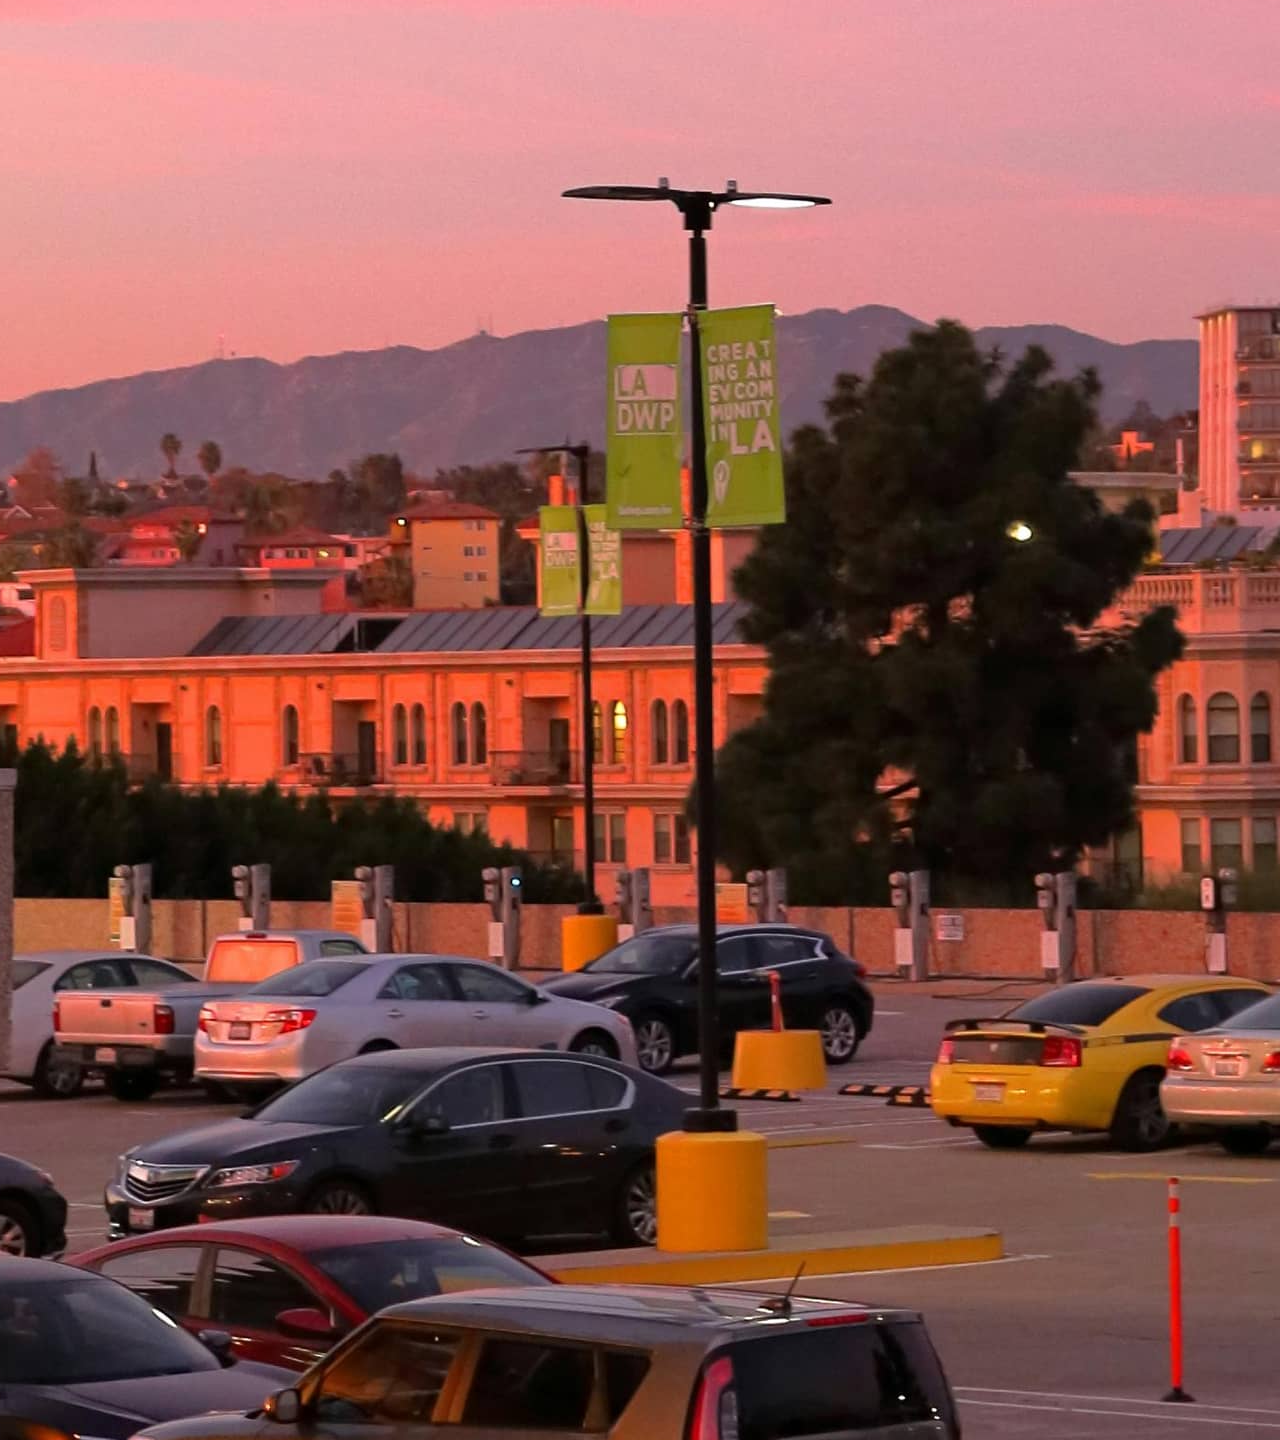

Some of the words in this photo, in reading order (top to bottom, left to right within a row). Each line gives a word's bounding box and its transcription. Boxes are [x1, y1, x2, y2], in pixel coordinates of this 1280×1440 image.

[618, 369, 649, 397] LA
[708, 364, 739, 383] ING
[746, 360, 773, 379] AN
[709, 384, 731, 403] EV
[734, 379, 774, 399] COM
[617, 402, 676, 432] DWP
[710, 400, 774, 422] MUNITY
[729, 419, 776, 456] LA
